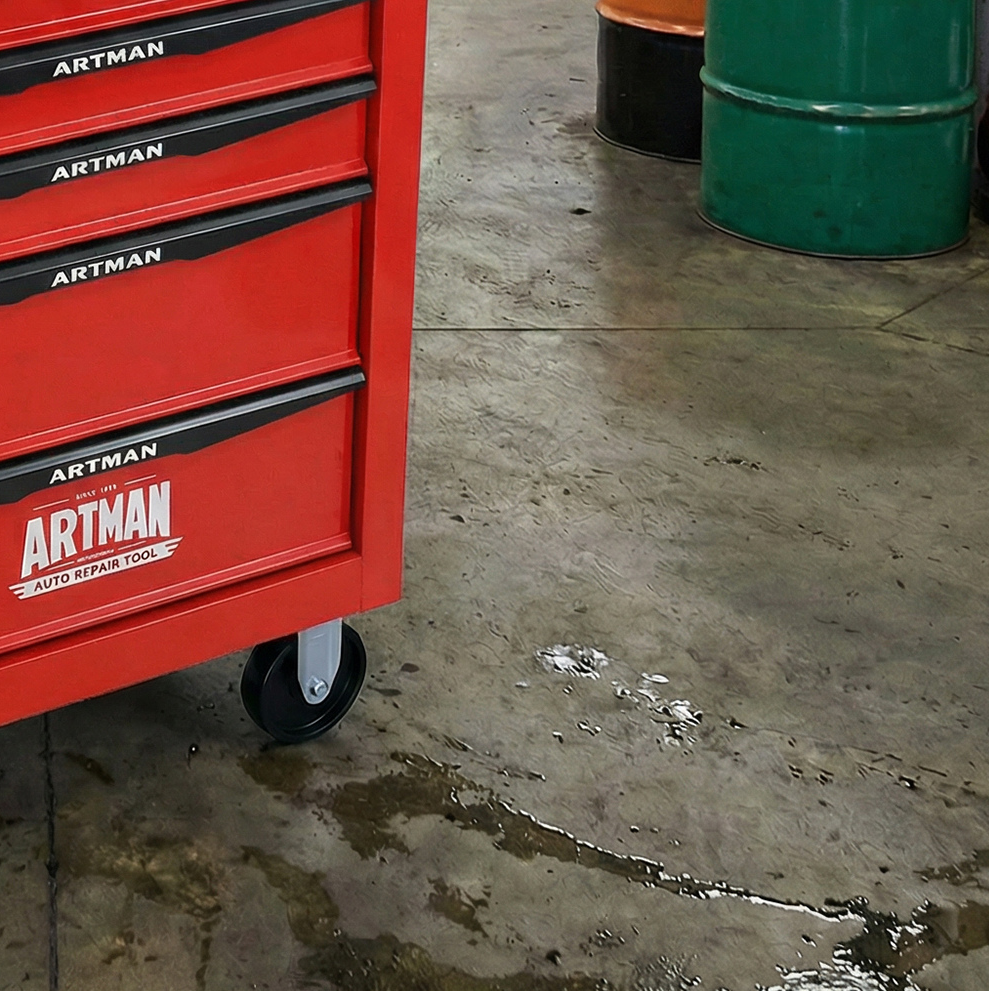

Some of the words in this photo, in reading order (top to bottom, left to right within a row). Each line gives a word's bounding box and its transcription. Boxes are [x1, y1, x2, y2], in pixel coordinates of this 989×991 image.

[52, 40, 164, 77] ARTMAN
[51, 142, 163, 182] ARTMAN
[50, 247, 161, 288] ARTMAN
[49, 442, 157, 485] ARTMAN
[20, 480, 171, 580] ARTMAN
[33, 573, 70, 592] AUTO
[74, 558, 120, 581] REPAIR
[124, 548, 158, 567] TOOL
